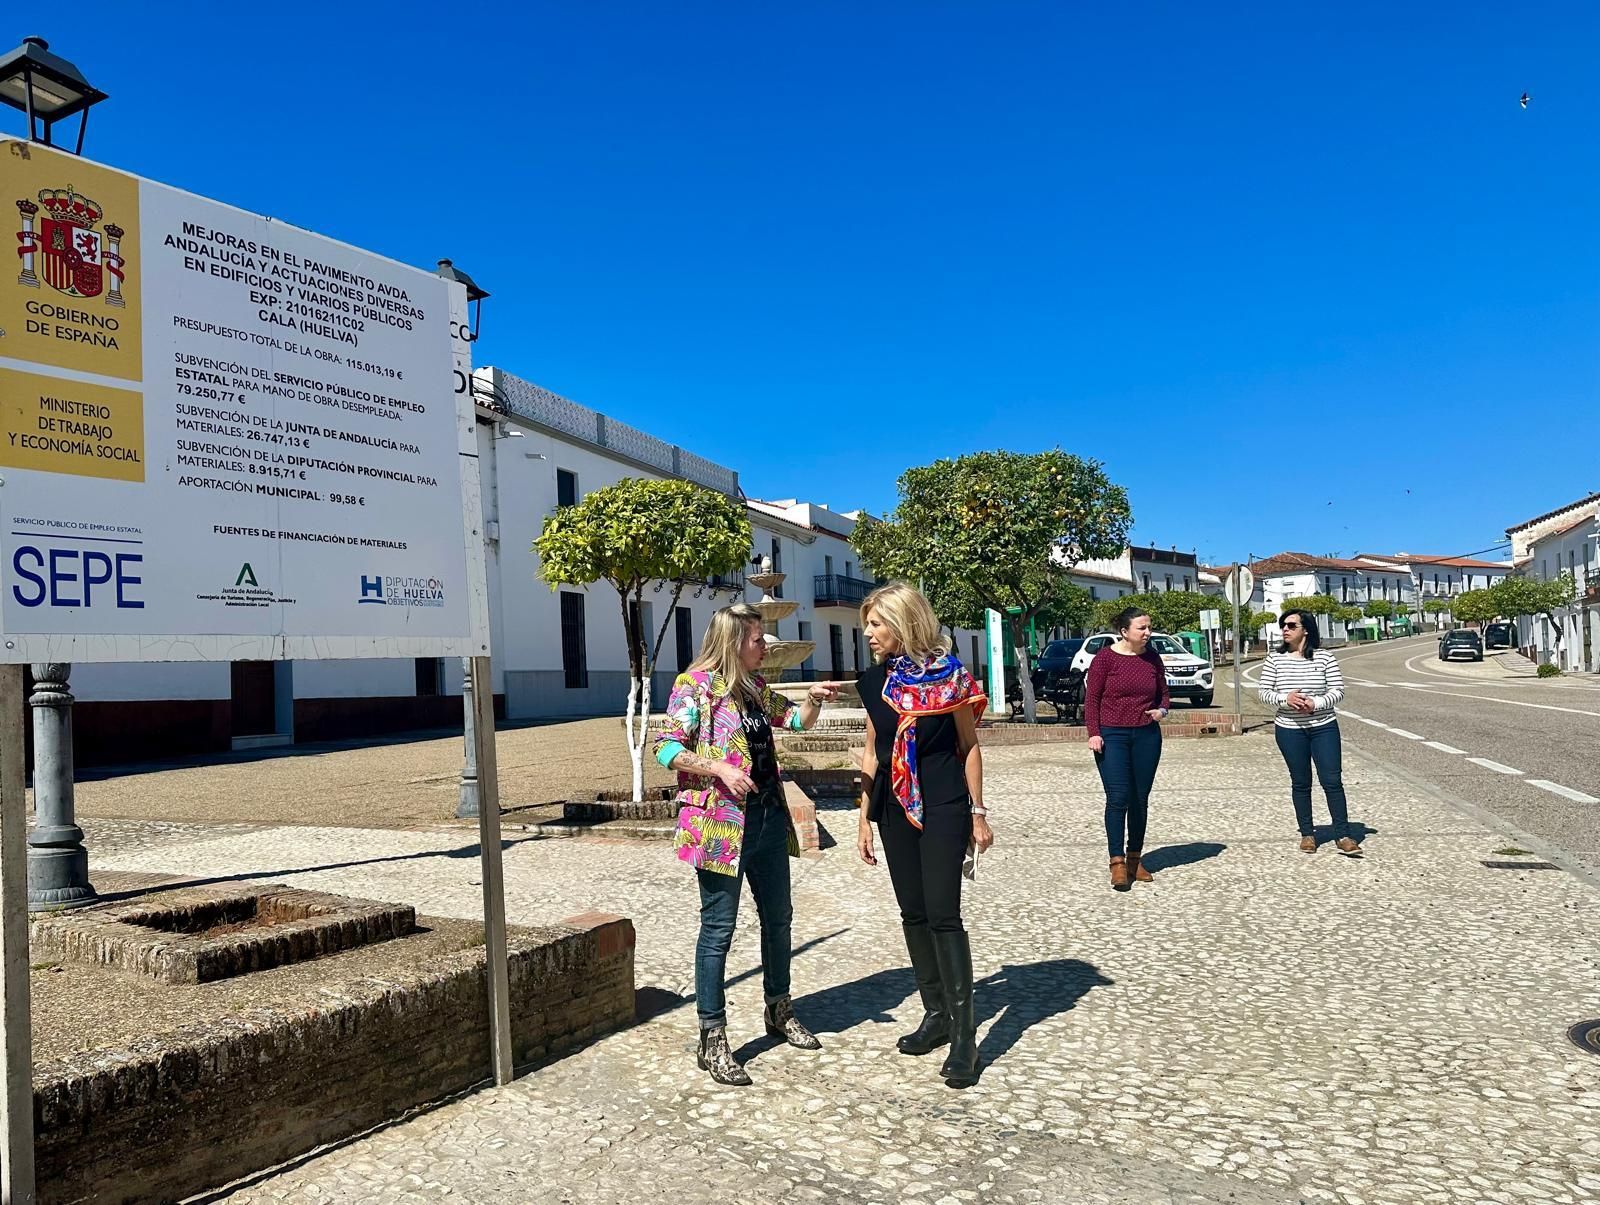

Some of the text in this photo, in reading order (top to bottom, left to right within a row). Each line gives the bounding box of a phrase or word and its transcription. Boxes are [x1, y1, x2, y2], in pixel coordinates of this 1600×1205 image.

[183, 221, 412, 302] MEJORAS EN EL PAVIMENTO AVDA.
[164, 234, 424, 321] ANDALUCÍA Y ACTUACIONES DIVERSAS
[184, 256, 413, 331] EN EDIFICIOS Y VIARIOS PÚBLICOS
[26, 300, 119, 331] GOBIERNO
[250, 290, 365, 332] EXP: 21016211C02
[26, 320, 120, 350] DE ESPAÑA
[258, 309, 358, 348] CALA (HUELVA)
[173, 316, 403, 380] PRESUPUESTO TOTAL DE LA OBRA: 115.013,19 €
[174, 352, 426, 414] SUBVENCIÓN DEL SERVICIO PÚBLICO DE EMPLEO
[175, 366, 403, 422] ESTATAL PARA MANO DE OBRA DESEMPLEADA:
[176, 383, 246, 405] 79.250,77 €
[40, 396, 110, 420] MINISTERIO
[38, 416, 113, 441] DE TRABAJO
[176, 403, 421, 455] SUBVENCIÓN DE LA JUNTA DE ANDALUCÍA PARA
[176, 418, 310, 449] MATERIALES: 26.747,13 €
[8, 432, 140, 463] Y ECONOMÍA SOCIAL
[176, 440, 438, 487] SUBVENCIÓN DE LA DIPUTACIÓN PROVINCIAL PARA
[177, 454, 306, 480] MATERIALES: 8.915,71 €
[178, 476, 253, 494] APORTACIÓN
[329, 493, 356, 506] 99,58
[358, 496, 366, 506] €
[12, 517, 46, 526] SERVICIO
[90, 524, 116, 532] EMPLEO
[213, 525, 408, 550] FUENTES DE FINANCIACIÓN DE MATERIALES
[12, 546, 145, 609] SEPE
[385, 576, 444, 590] DIPUTACIÓN
[386, 588, 444, 600] DE HUELVA
[387, 598, 424, 607] OBJETIVOS
